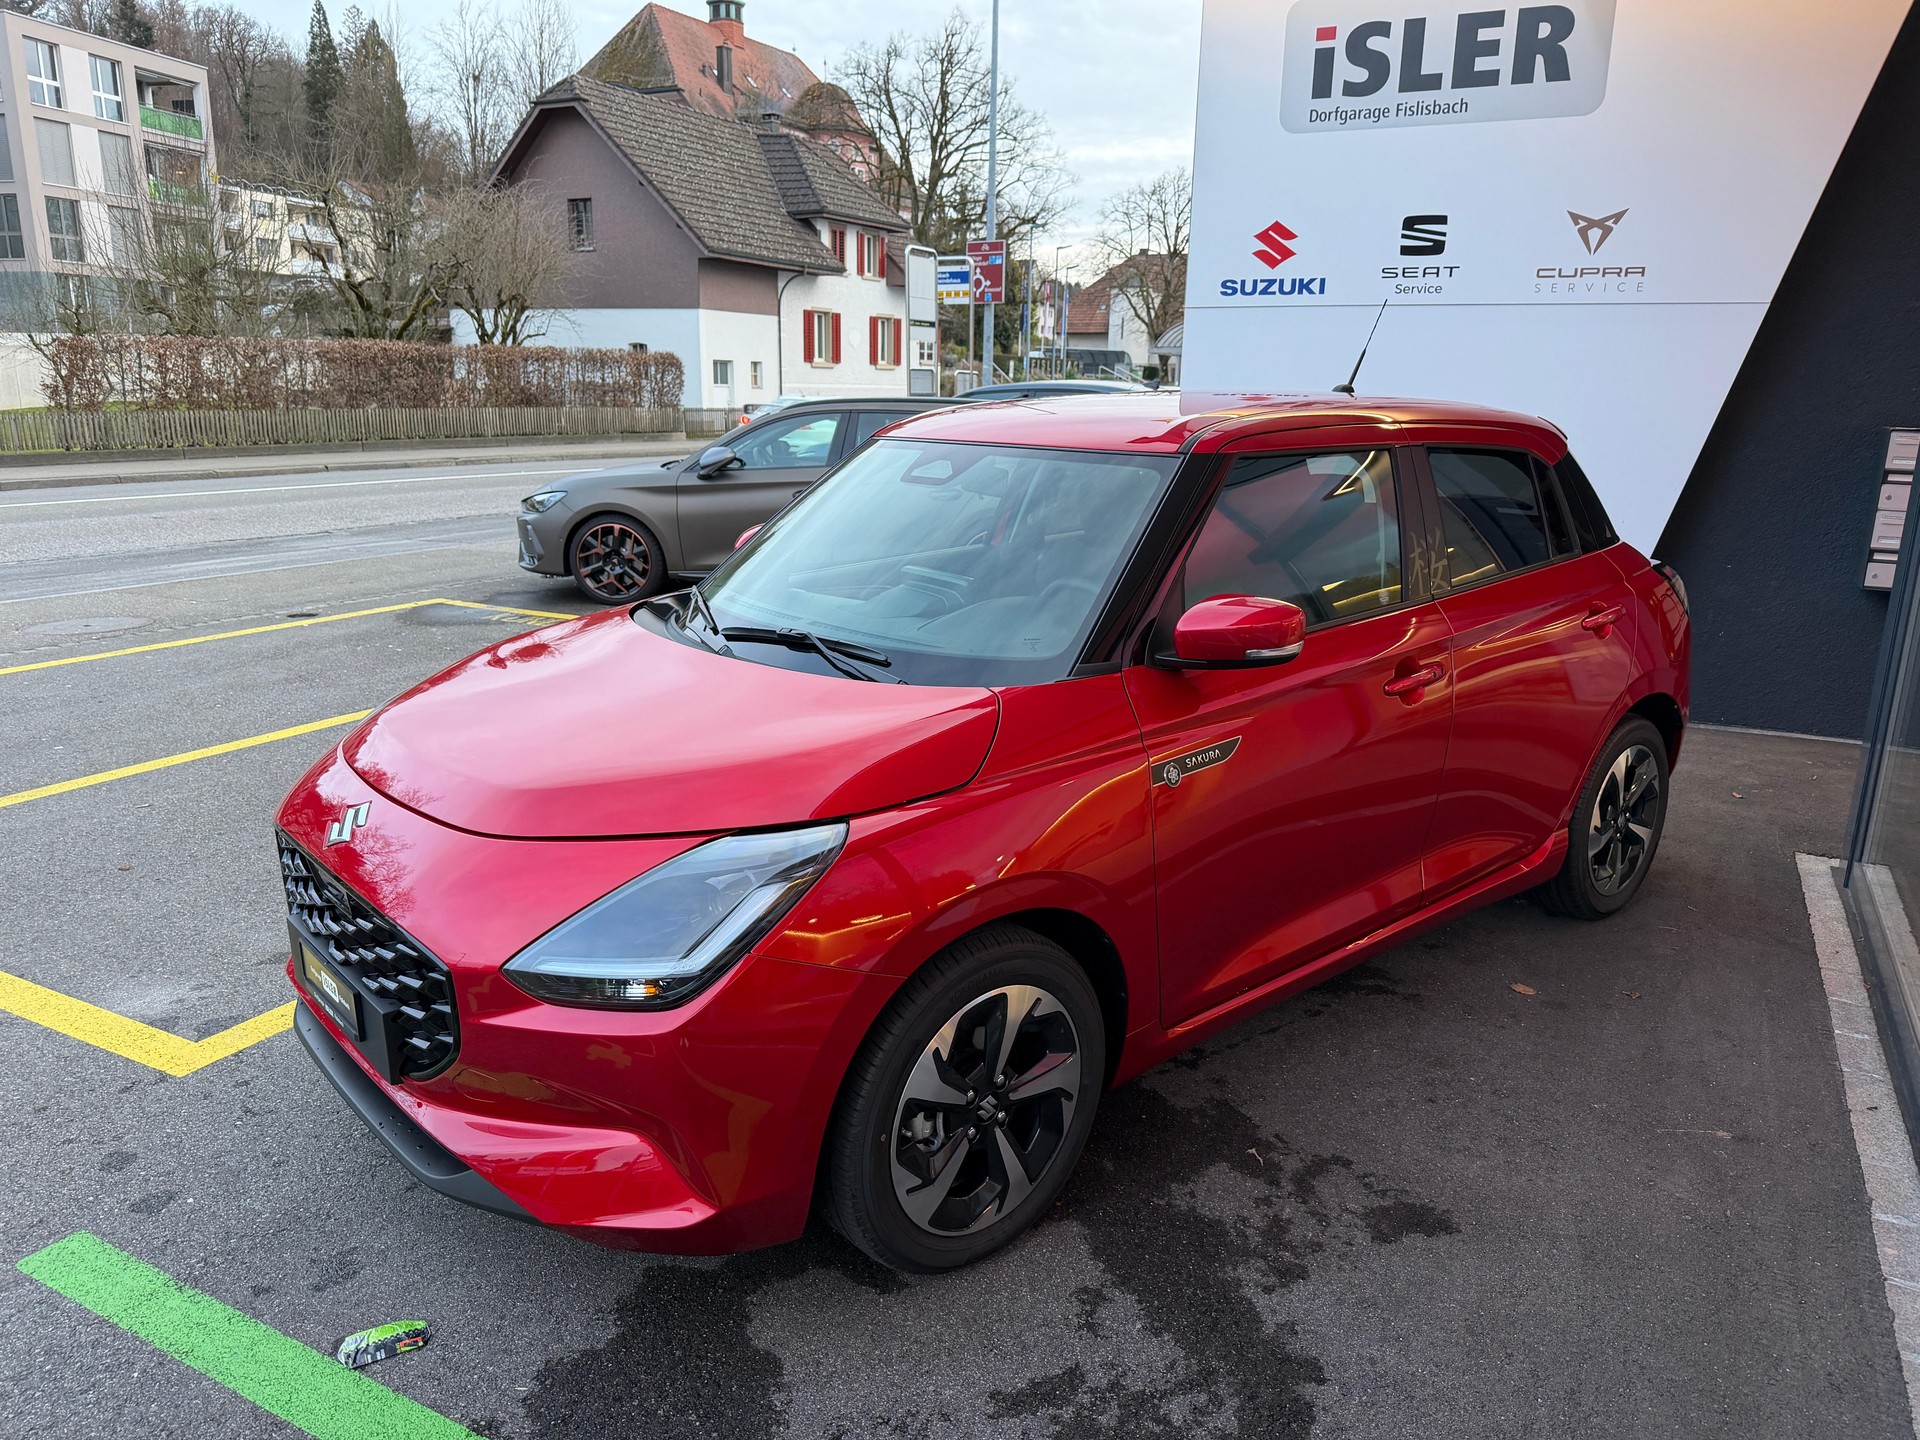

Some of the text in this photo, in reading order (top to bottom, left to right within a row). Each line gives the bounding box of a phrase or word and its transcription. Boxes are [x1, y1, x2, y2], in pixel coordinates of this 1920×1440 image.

[1309, 98, 1469, 125] Dorfgarage Fislisbach
[1381, 266, 1461, 279] SEAT
[1535, 266, 1646, 279] CUPRA
[1219, 277, 1327, 297] SUZUKI
[1394, 282, 1443, 295] Service
[1534, 282, 1645, 293] SERVICE
[1185, 749, 1222, 768] SAKURA
